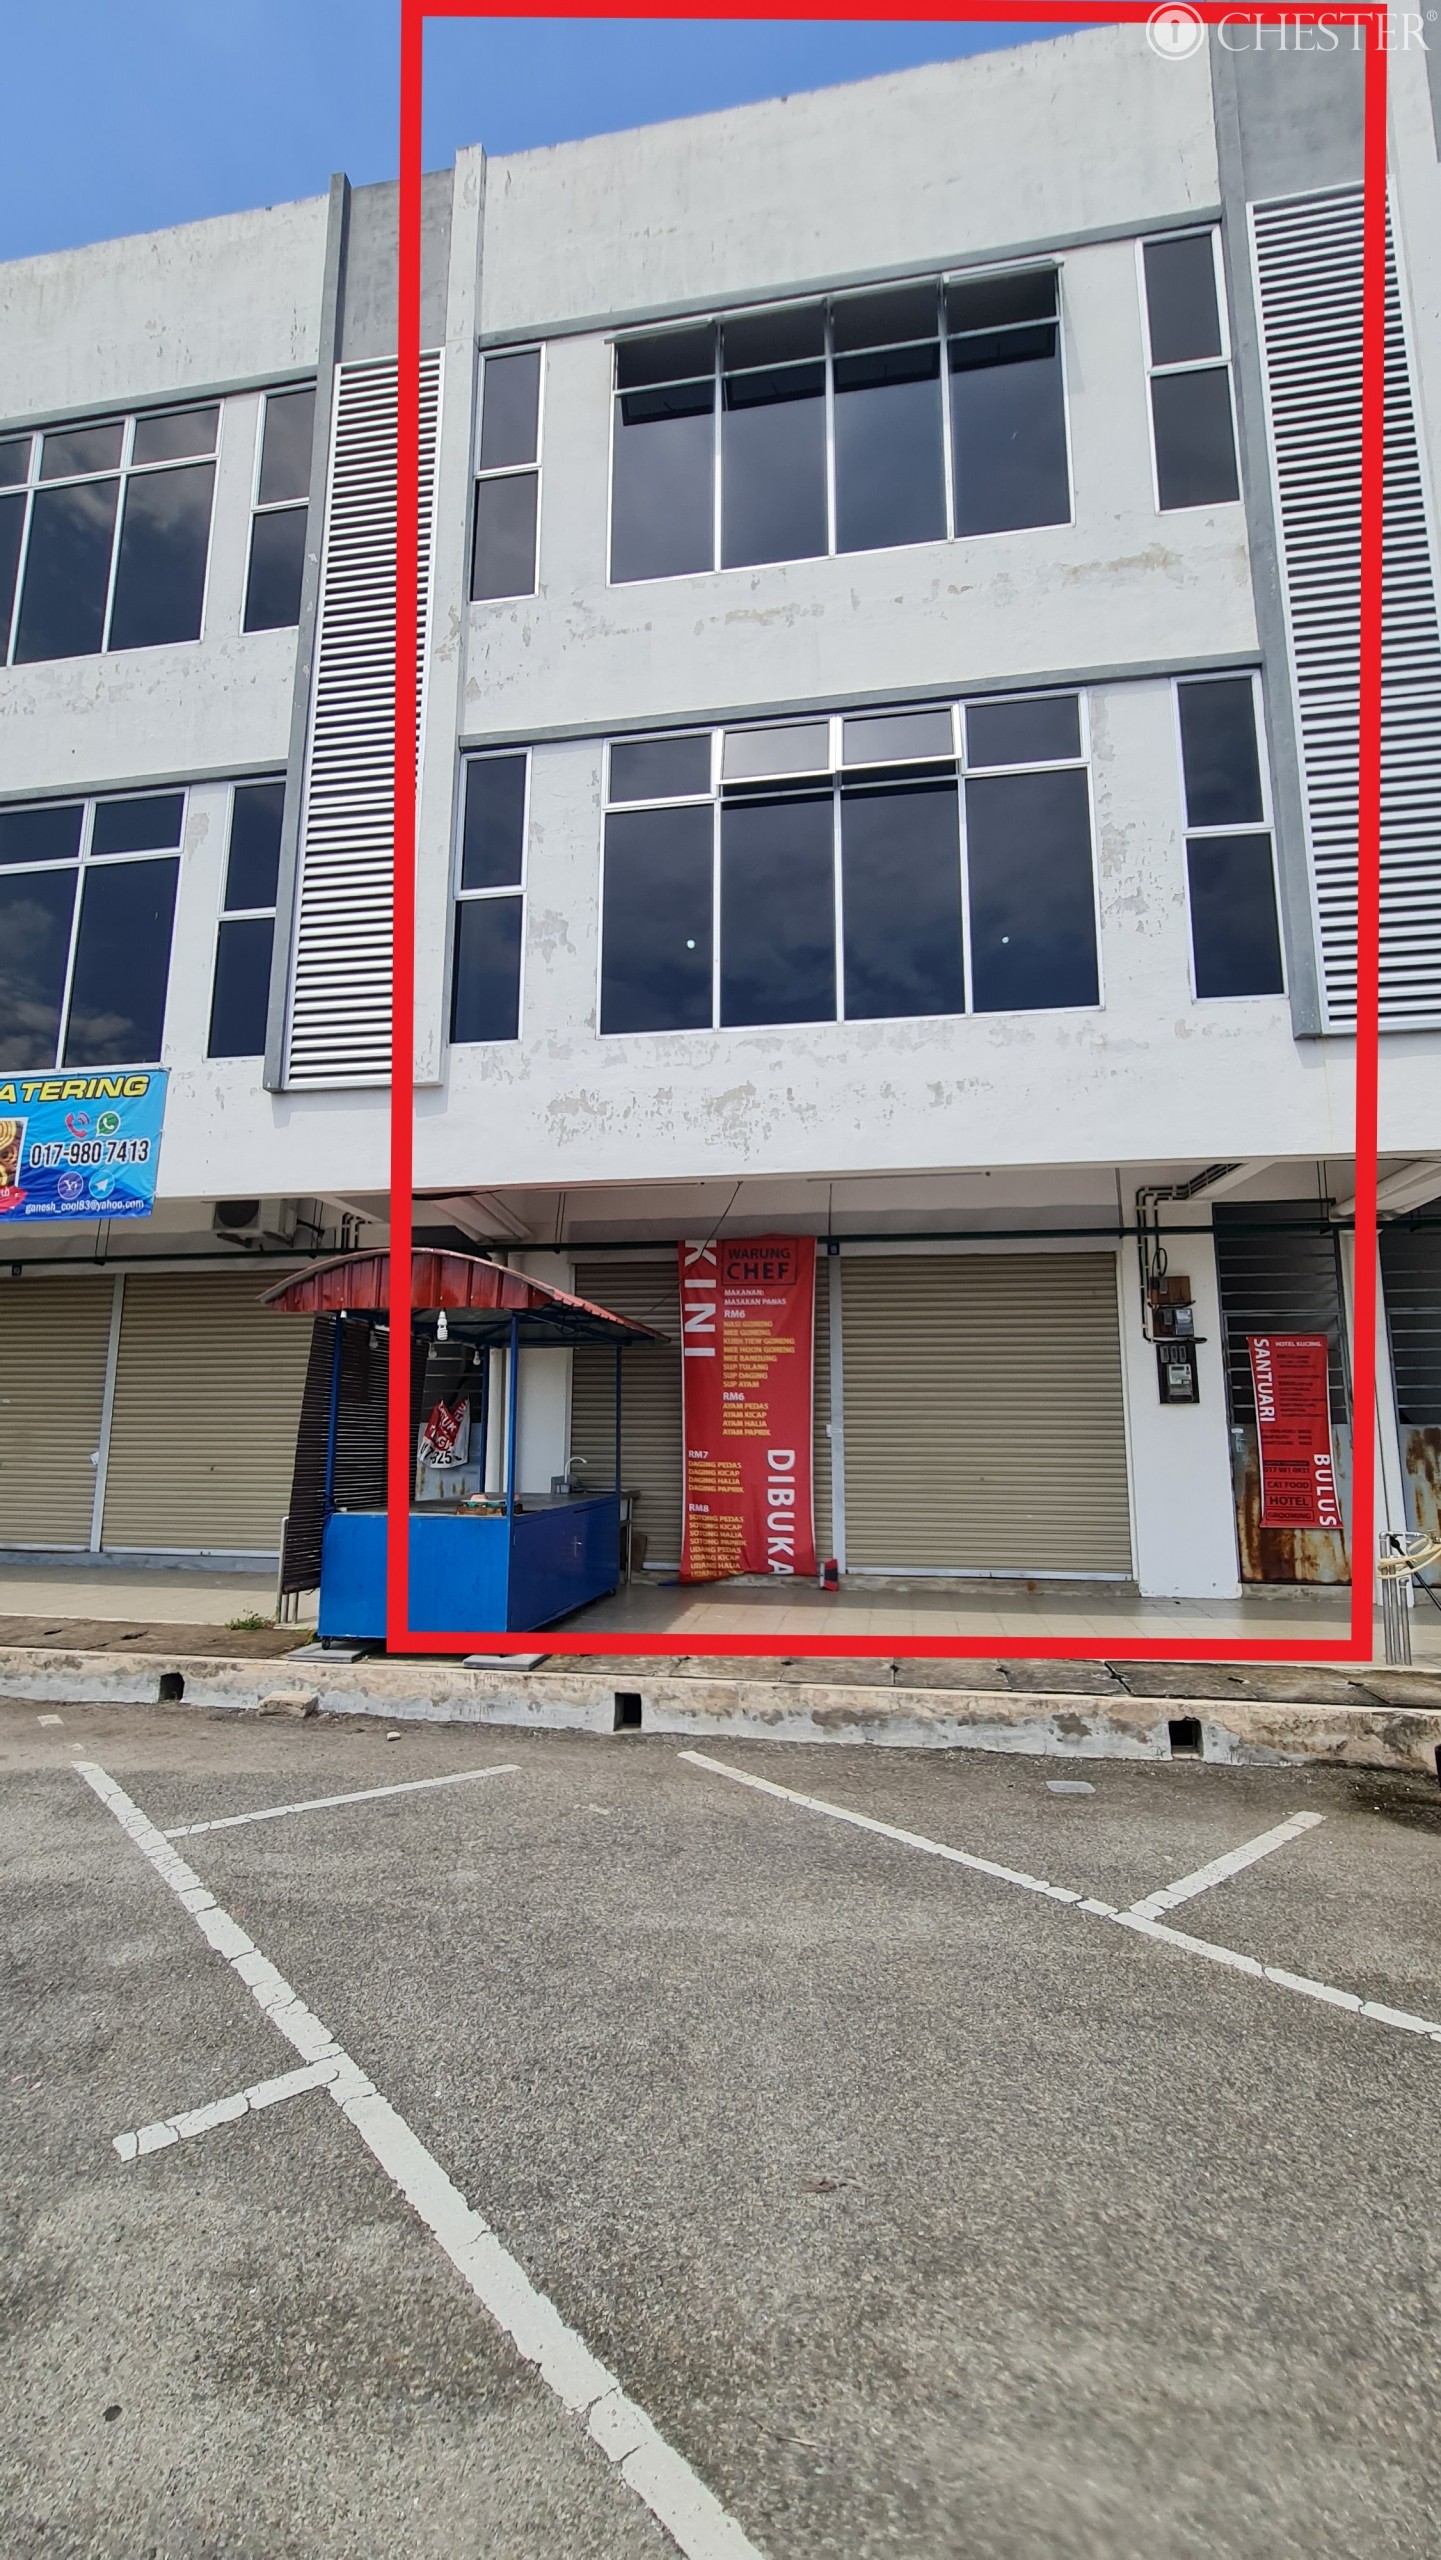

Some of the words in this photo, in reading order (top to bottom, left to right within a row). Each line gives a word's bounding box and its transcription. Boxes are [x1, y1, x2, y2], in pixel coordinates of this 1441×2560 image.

[30, 1141, 102, 1168] 017-980
[106, 1139, 149, 1164] 7413
[25, 1199, 144, 1214] ganesh_cool83@yahoo.com
[728, 1247, 790, 1259] WARUNG
[726, 1262, 789, 1280] CHEF
[685, 1240, 717, 1356] KINI
[723, 1298, 761, 1306] MASAKAN
[723, 1309, 746, 1319] RM6
[763, 1346, 795, 1354] GORENG
[723, 1363, 738, 1371] SUP
[738, 1363, 768, 1371] TULANG
[1253, 1338, 1275, 1421] SANTUARI
[723, 1391, 745, 1401] RM6
[688, 1449, 709, 1459] RM7
[688, 1460, 716, 1468] DAGING
[717, 1461, 742, 1469] PEDAS
[717, 1469, 740, 1477] KICAP
[1285, 1481, 1309, 1489] FOOD
[1314, 1454, 1337, 1526] BULUS
[1269, 1496, 1309, 1506] HOTEL
[688, 1503, 709, 1512] RM8
[767, 1449, 795, 1574] DIBUKA
[689, 1514, 718, 1522] SOTONG
[1267, 1512, 1311, 1520] GROOMING
[689, 1522, 718, 1530] SOTONG
[689, 1530, 719, 1538] SOTONG
[720, 1531, 743, 1539] HALIA
[690, 1538, 719, 1546] SOTONG
[717, 1546, 742, 1554] PEDAS
